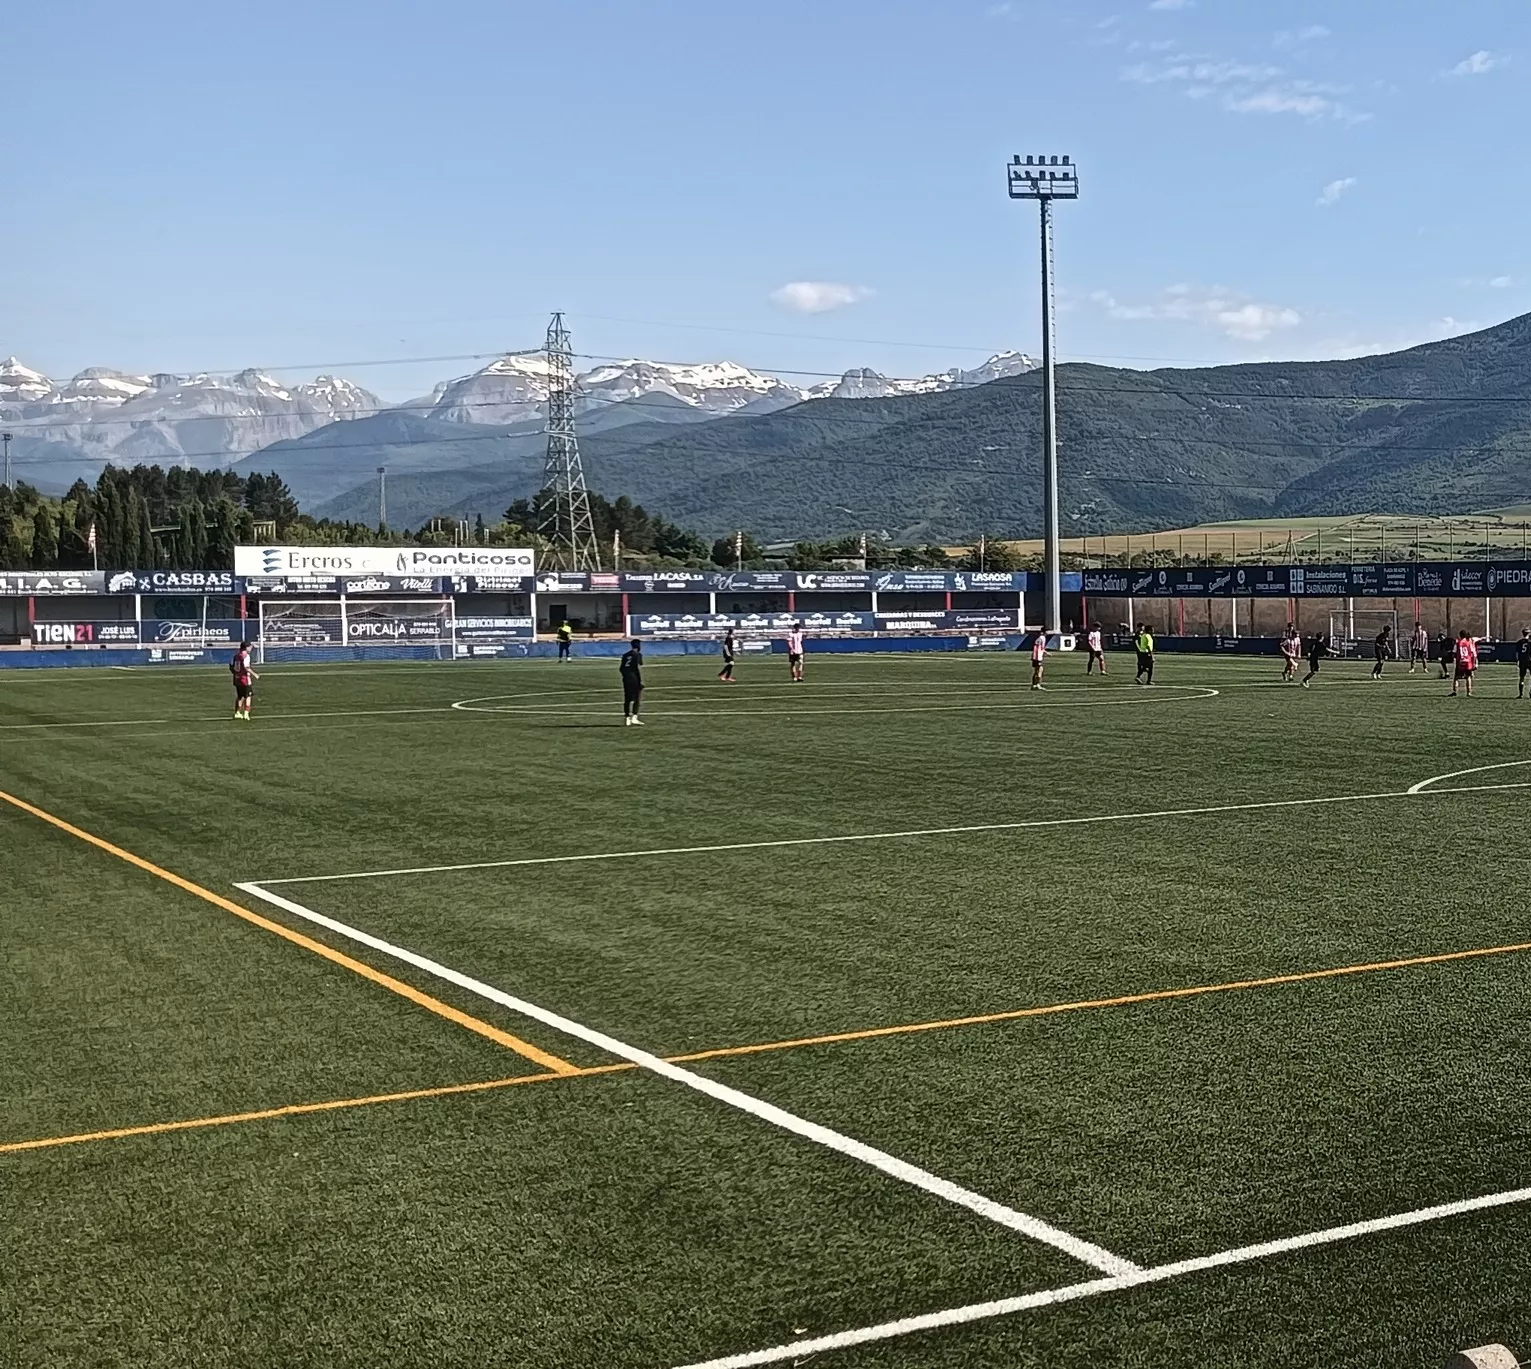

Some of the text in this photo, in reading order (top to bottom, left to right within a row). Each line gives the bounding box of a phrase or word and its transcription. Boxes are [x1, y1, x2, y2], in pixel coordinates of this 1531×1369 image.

[289, 552, 352, 569] Ercros
[412, 551, 532, 566] Panticosa
[153, 572, 232, 586] CASBAS
[654, 572, 691, 581] LACASA
[1522, 643, 1528, 653] 5
[625, 655, 632, 667] 2
